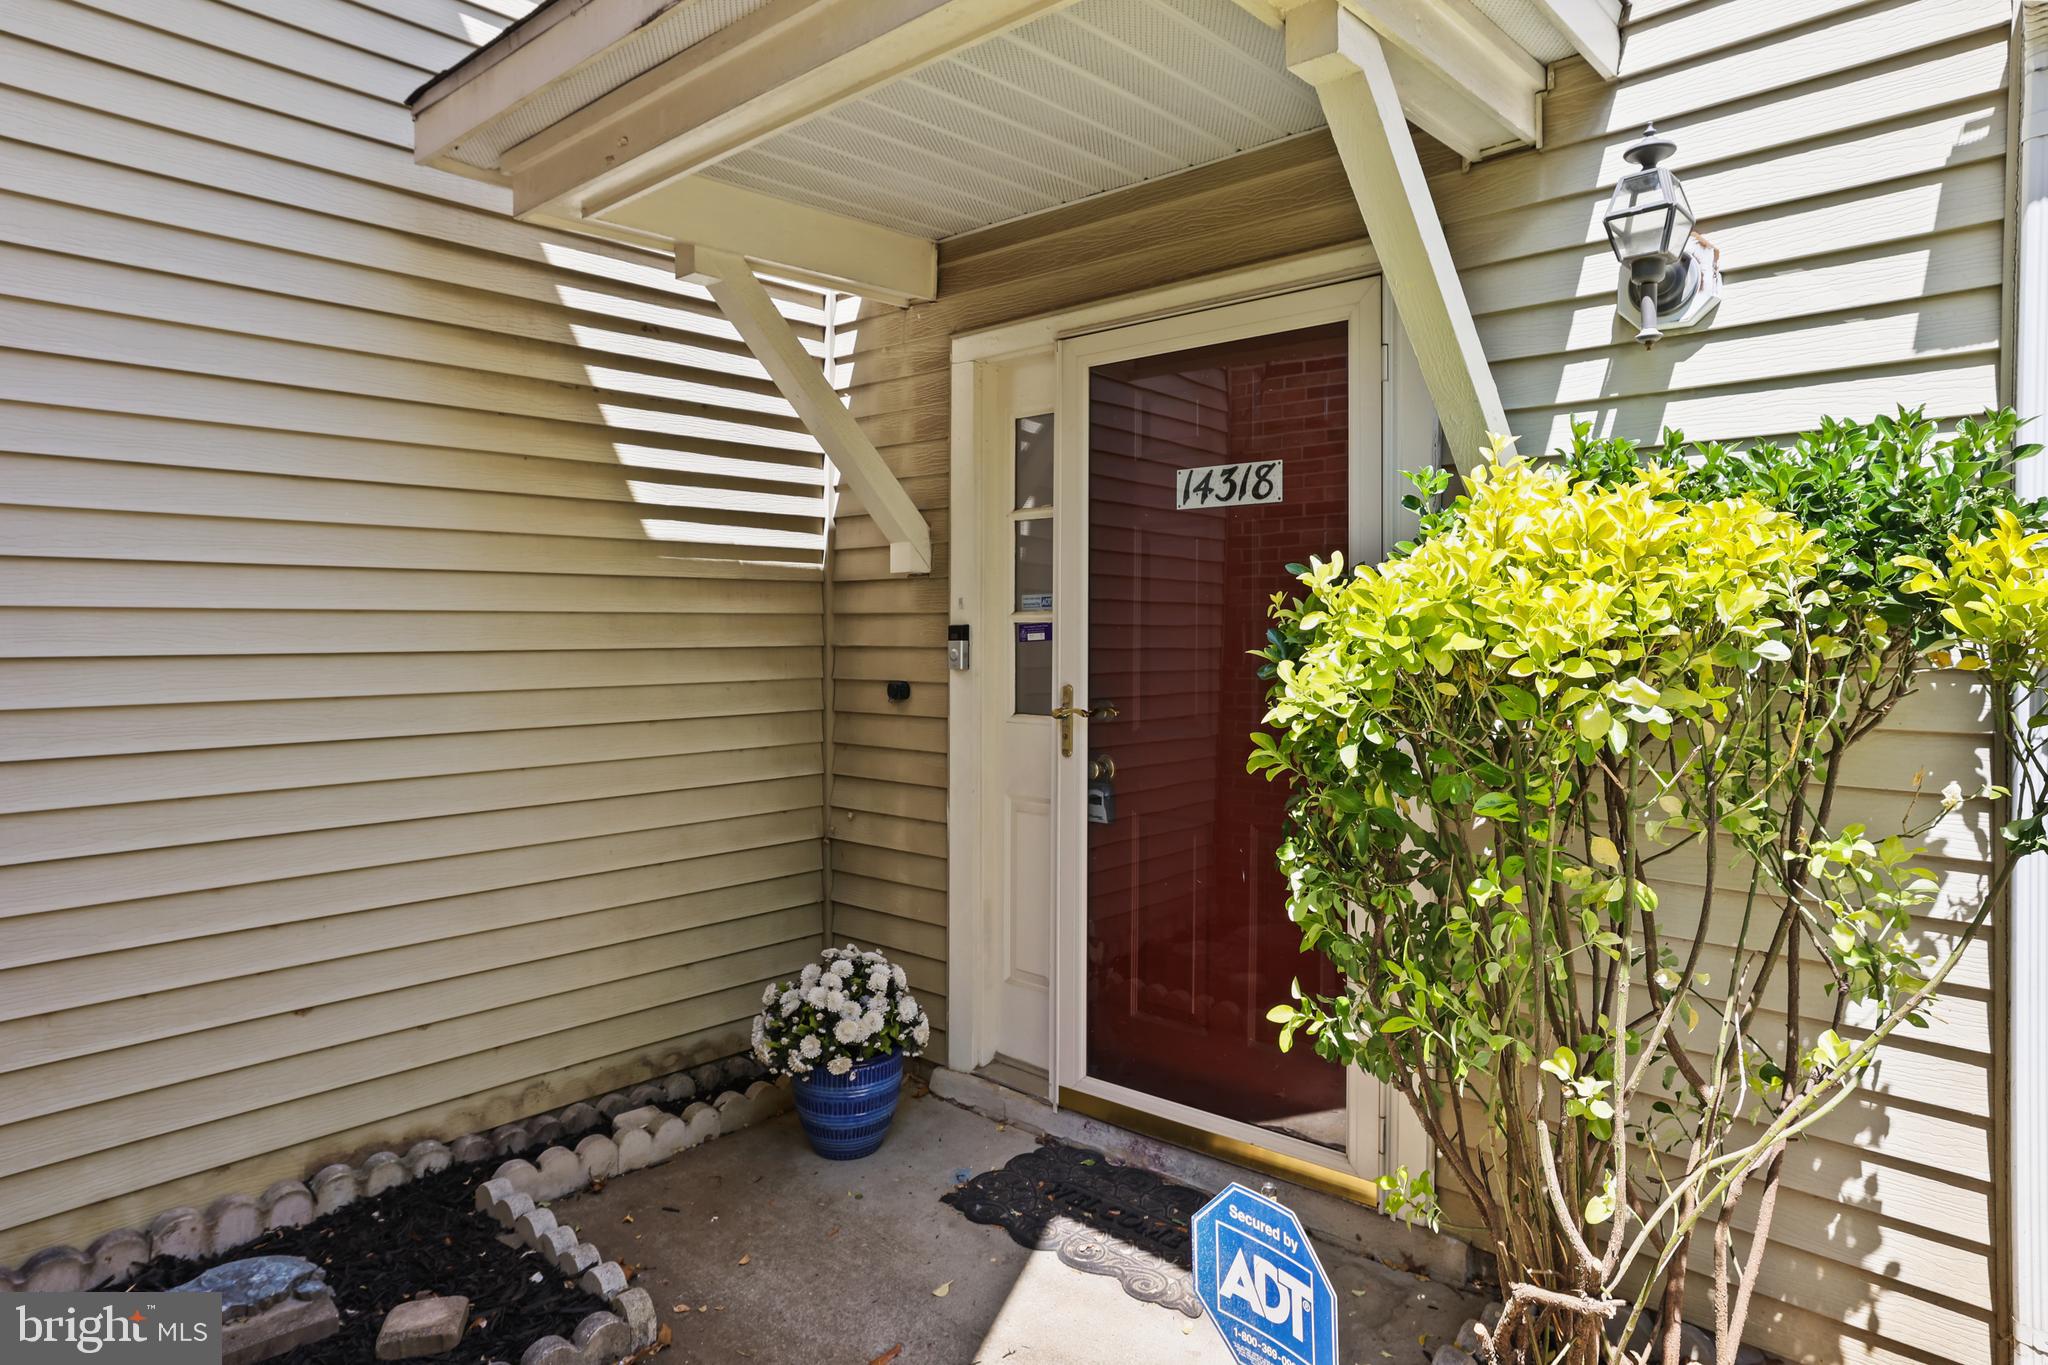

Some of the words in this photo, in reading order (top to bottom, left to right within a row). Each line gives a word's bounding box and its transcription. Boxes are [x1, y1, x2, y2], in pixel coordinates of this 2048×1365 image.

[1183, 463, 1276, 505] 14318
[1229, 1204, 1281, 1242] Secured
[1283, 1231, 1299, 1254] by
[1219, 1247, 1314, 1343] ADT
